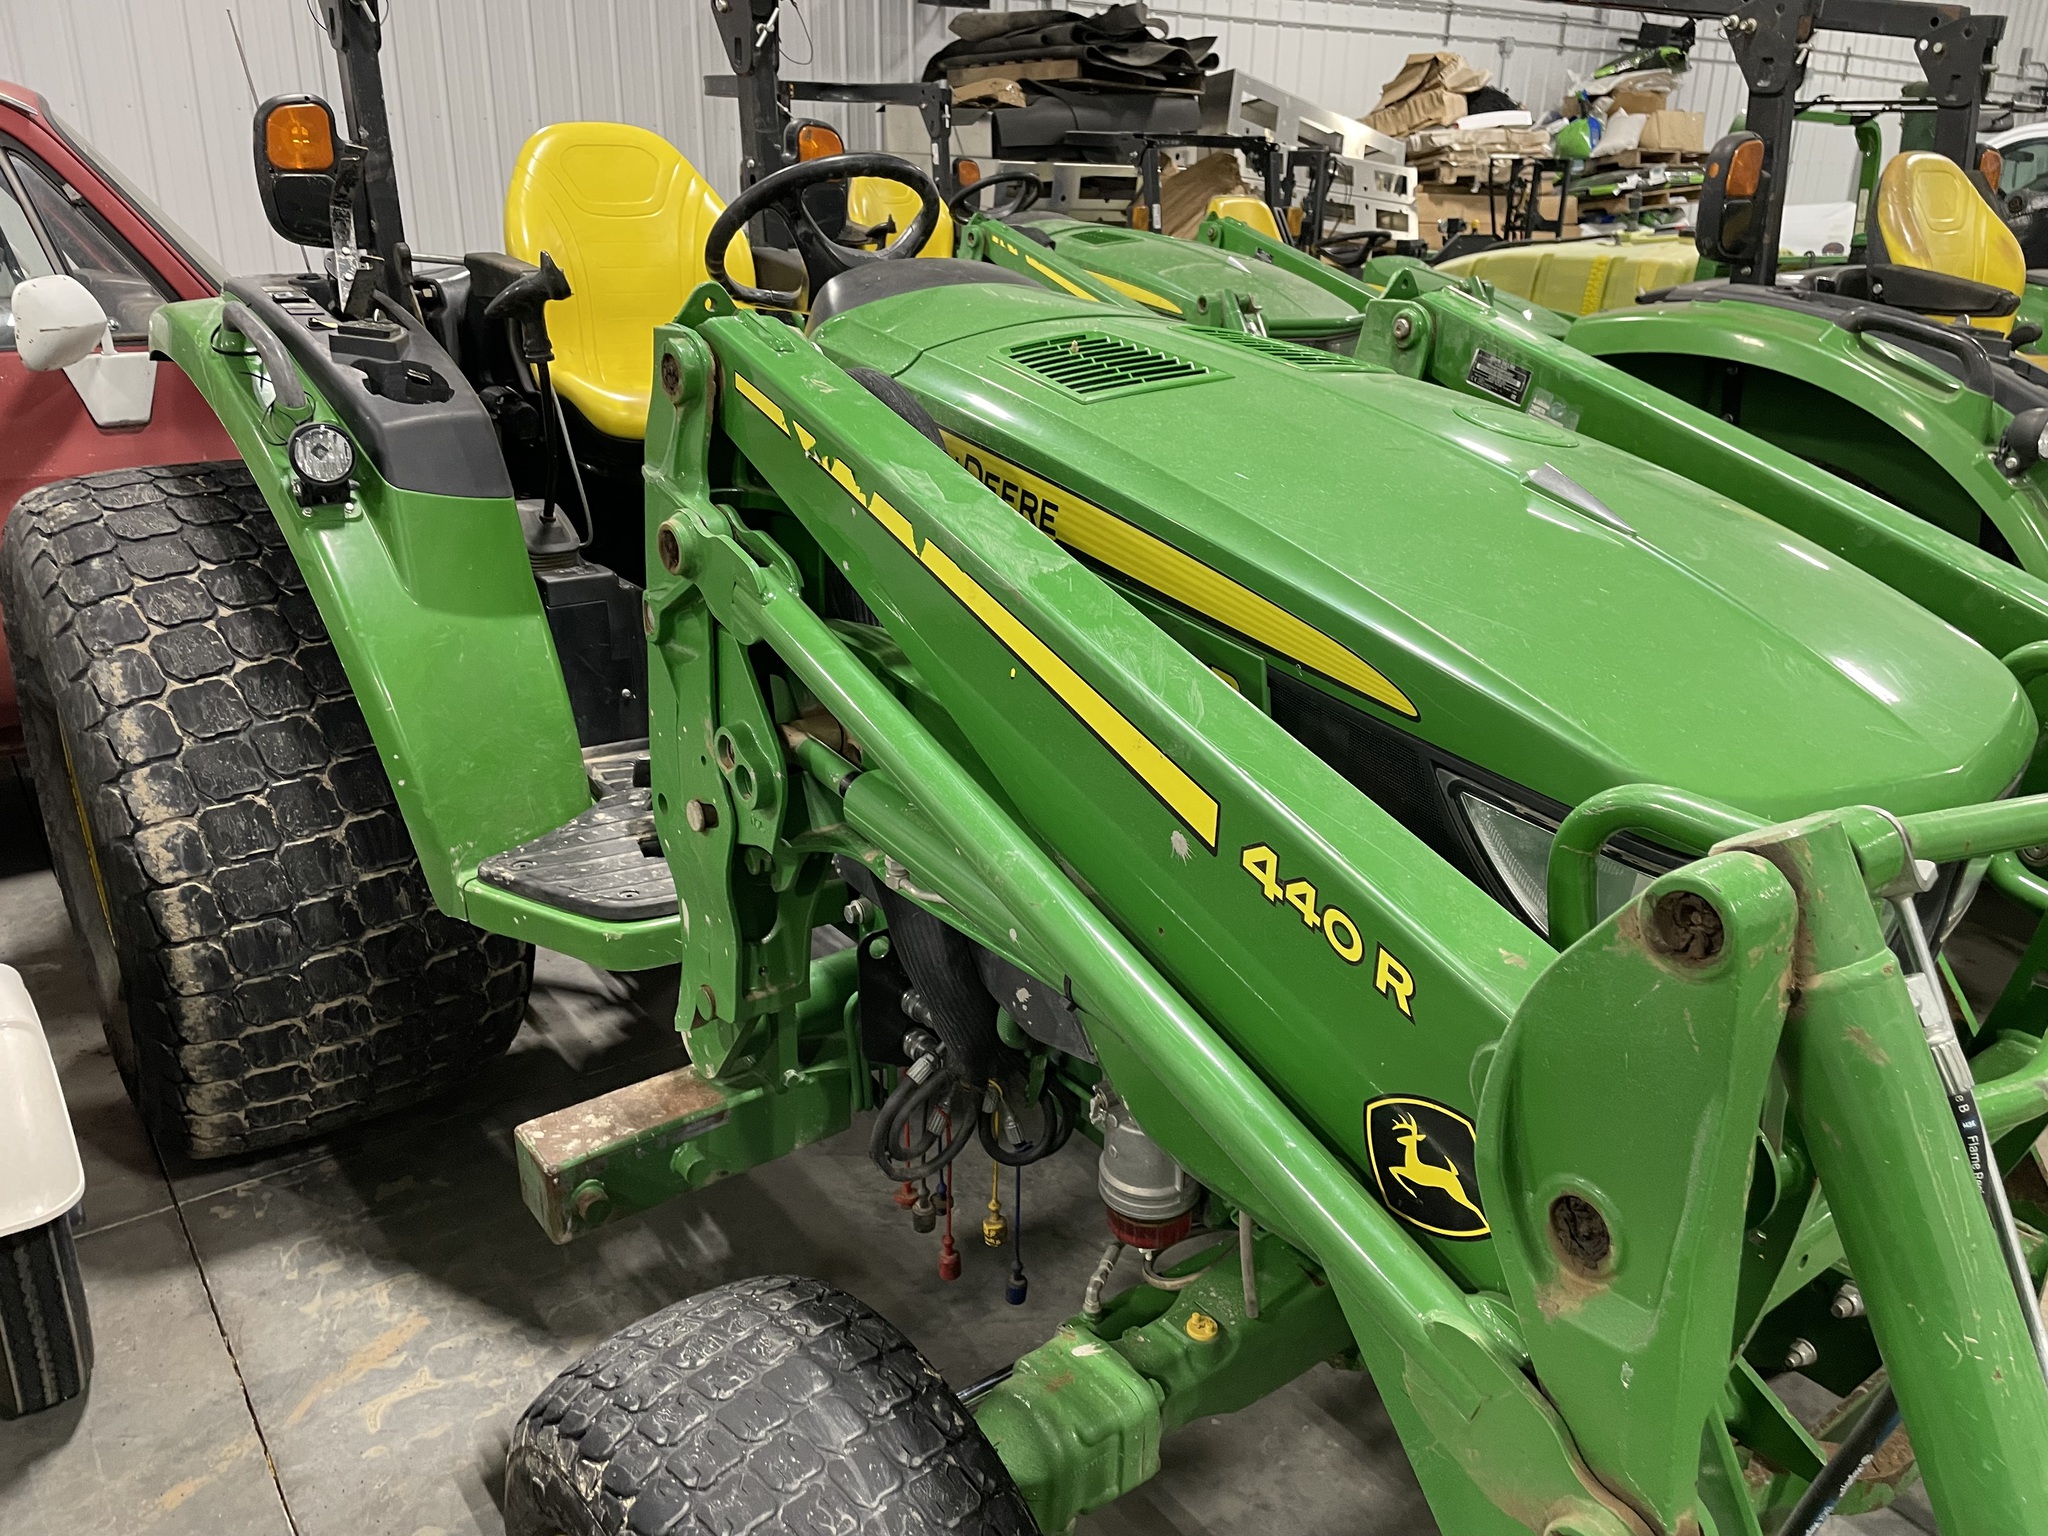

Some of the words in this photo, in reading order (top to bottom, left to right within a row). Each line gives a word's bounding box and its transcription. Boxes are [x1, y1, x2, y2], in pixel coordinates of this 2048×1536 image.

[1240, 841, 1365, 966] 440
[1373, 941, 1416, 1025] R
[1967, 1134, 1982, 1171] Flame
